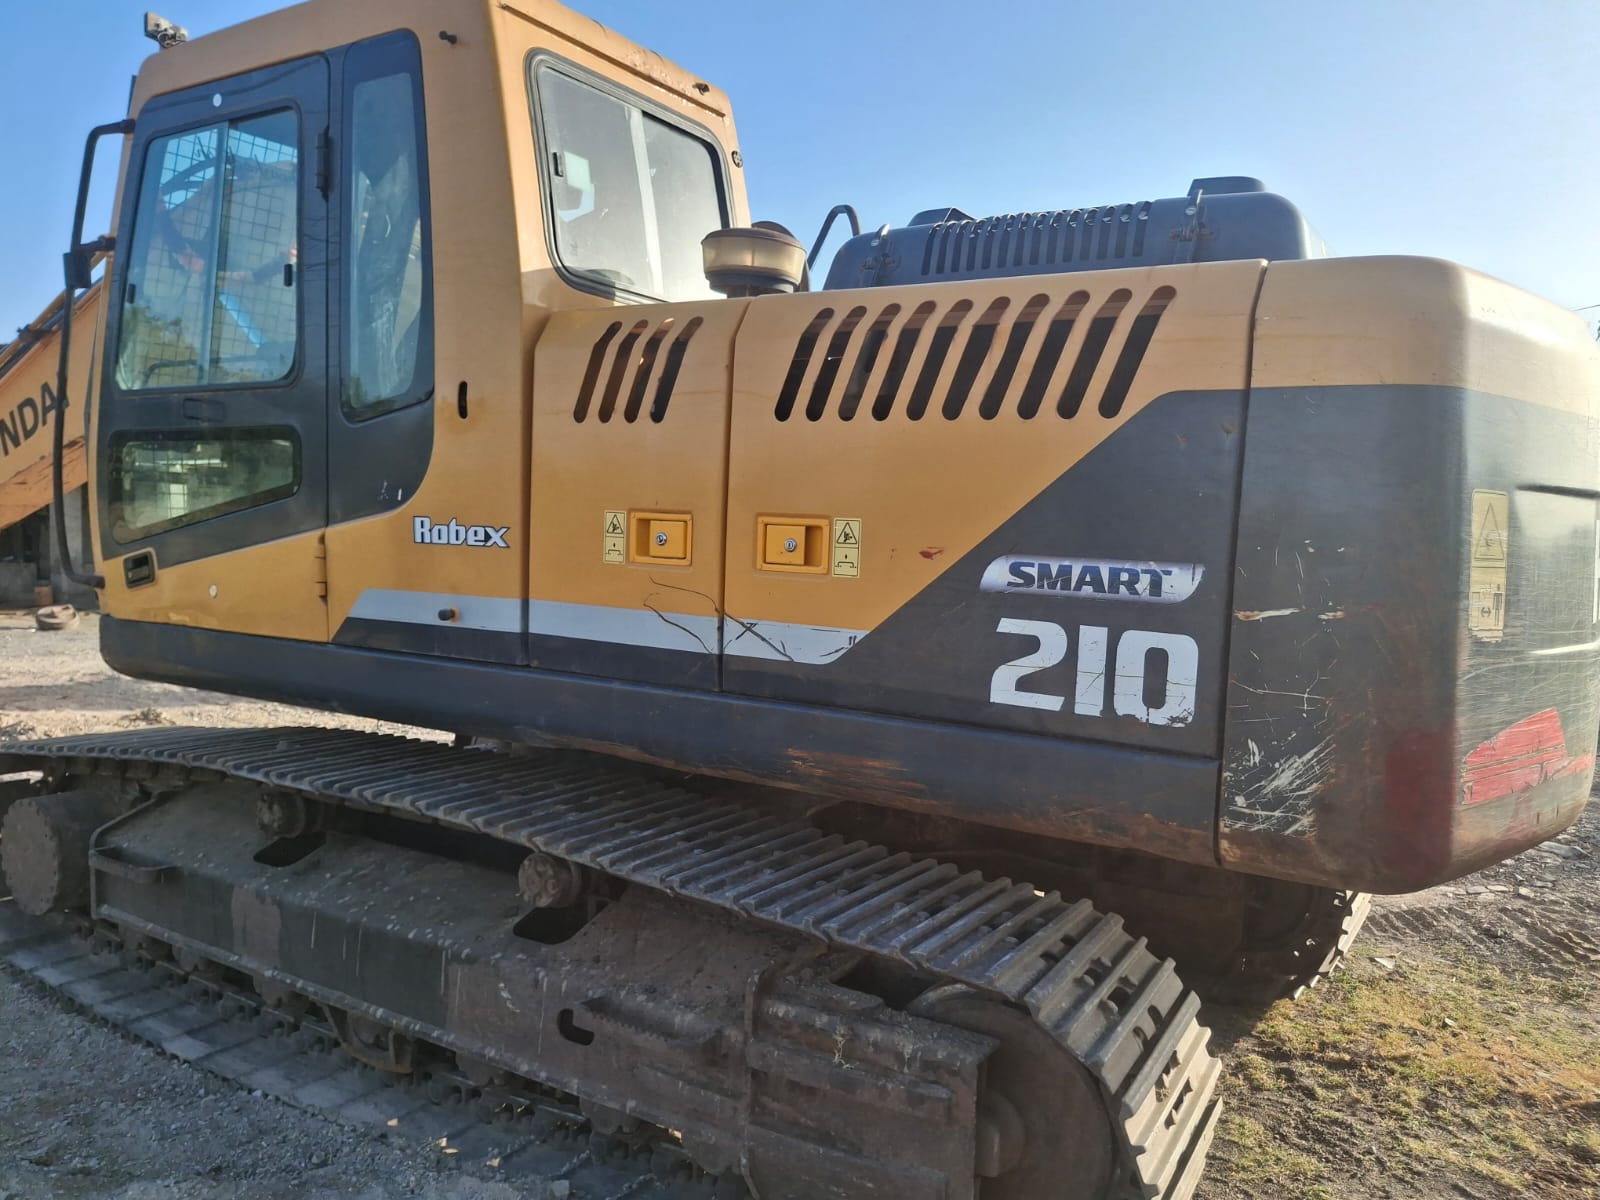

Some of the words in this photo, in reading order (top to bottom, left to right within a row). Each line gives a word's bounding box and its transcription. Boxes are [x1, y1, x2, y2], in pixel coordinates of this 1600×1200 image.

[0, 378, 69, 457] NDA
[413, 516, 510, 548] Robex
[1007, 561, 1173, 597] SMART
[989, 617, 1199, 728] 210
